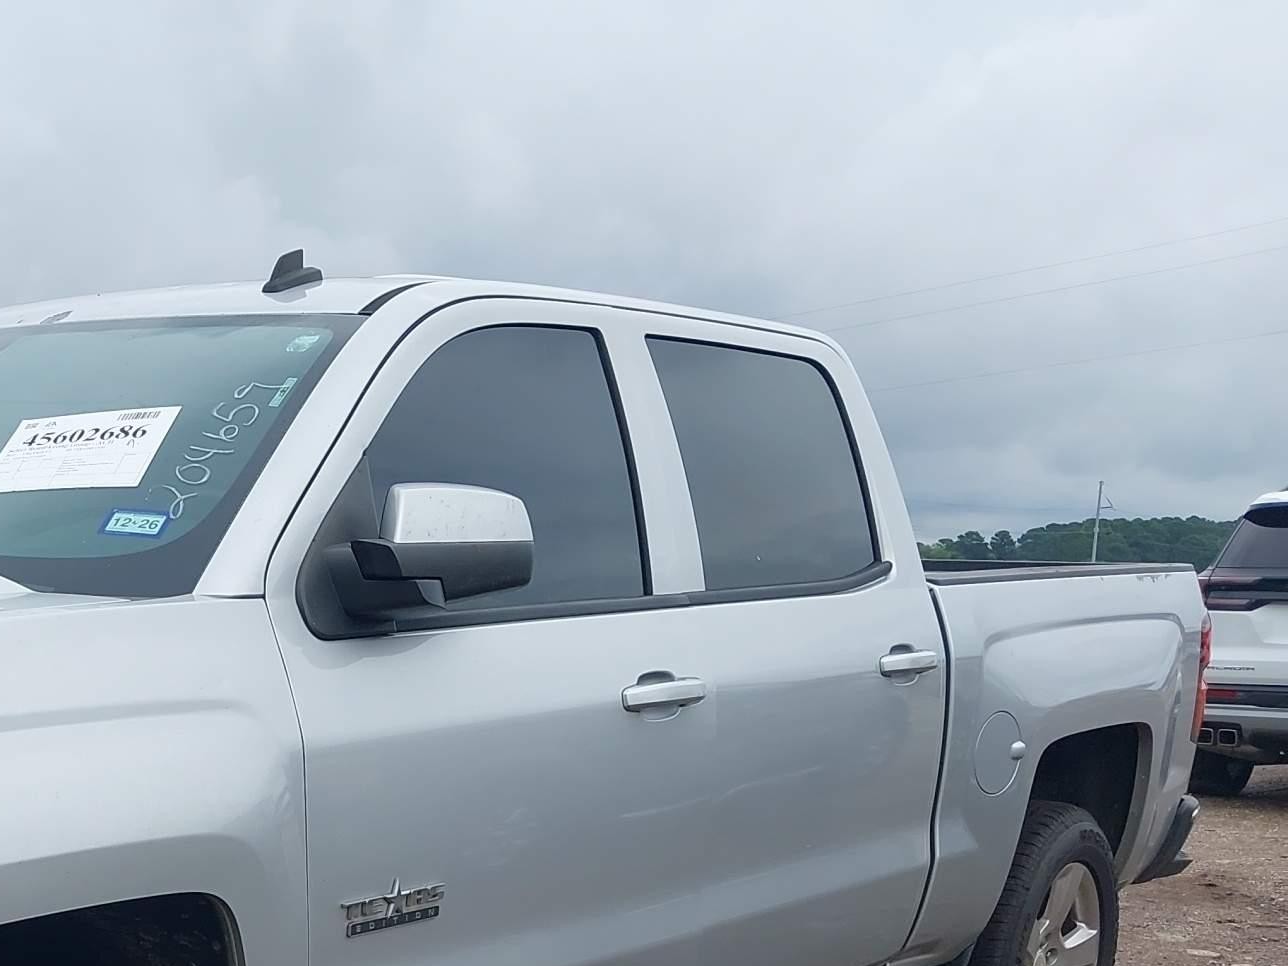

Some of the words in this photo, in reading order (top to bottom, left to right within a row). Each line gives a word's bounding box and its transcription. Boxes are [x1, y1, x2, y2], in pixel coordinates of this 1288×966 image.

[23, 423, 151, 447] 45602686
[340, 878, 446, 921] TEXAS
[355, 908, 435, 933] EDITION
